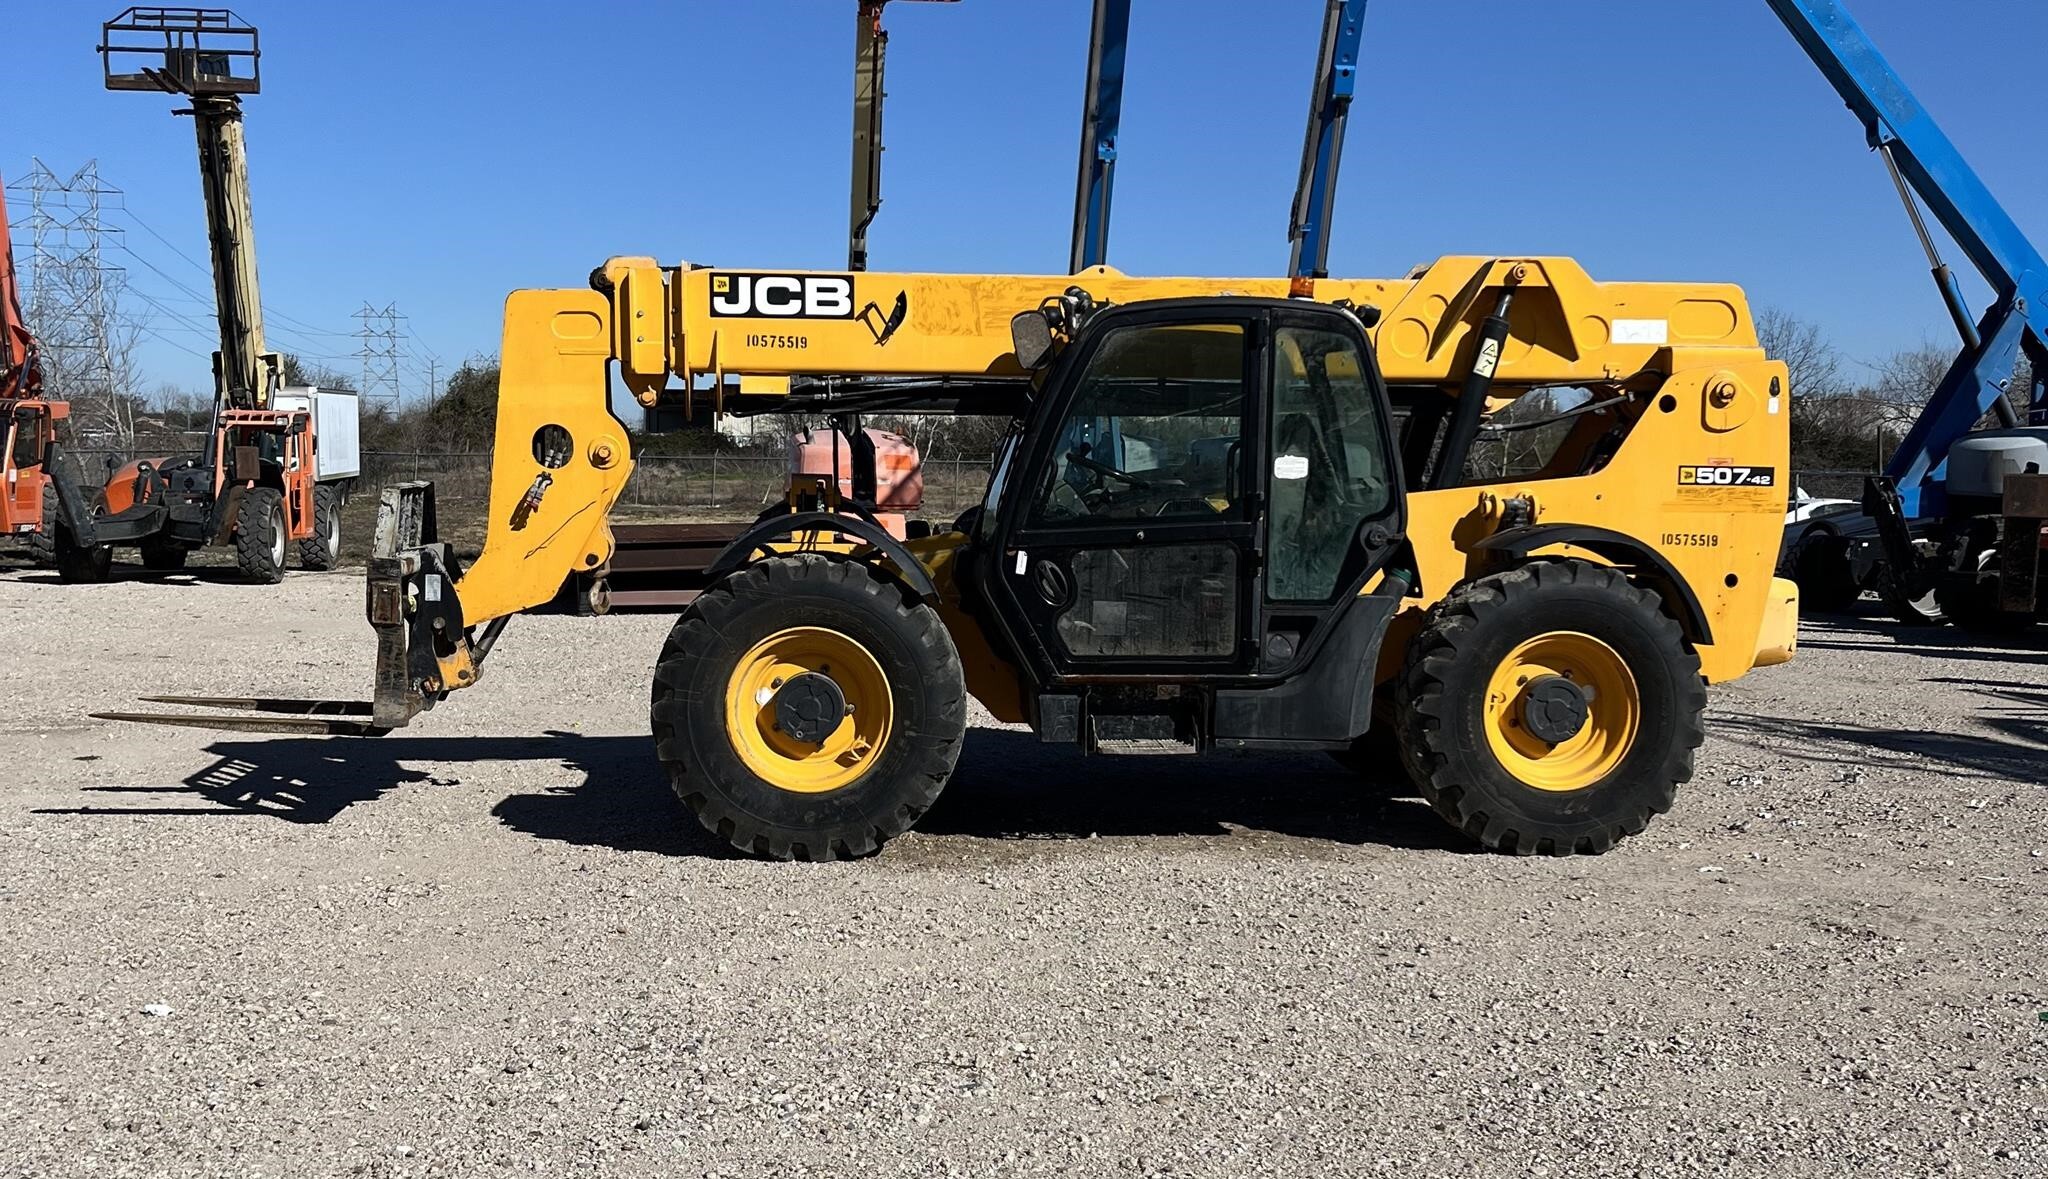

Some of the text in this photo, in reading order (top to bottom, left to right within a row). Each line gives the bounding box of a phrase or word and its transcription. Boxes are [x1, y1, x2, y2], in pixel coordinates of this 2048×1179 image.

[713, 276, 852, 316] JCB
[746, 334, 808, 349] 10575519
[1661, 533, 1719, 547] 10575519
